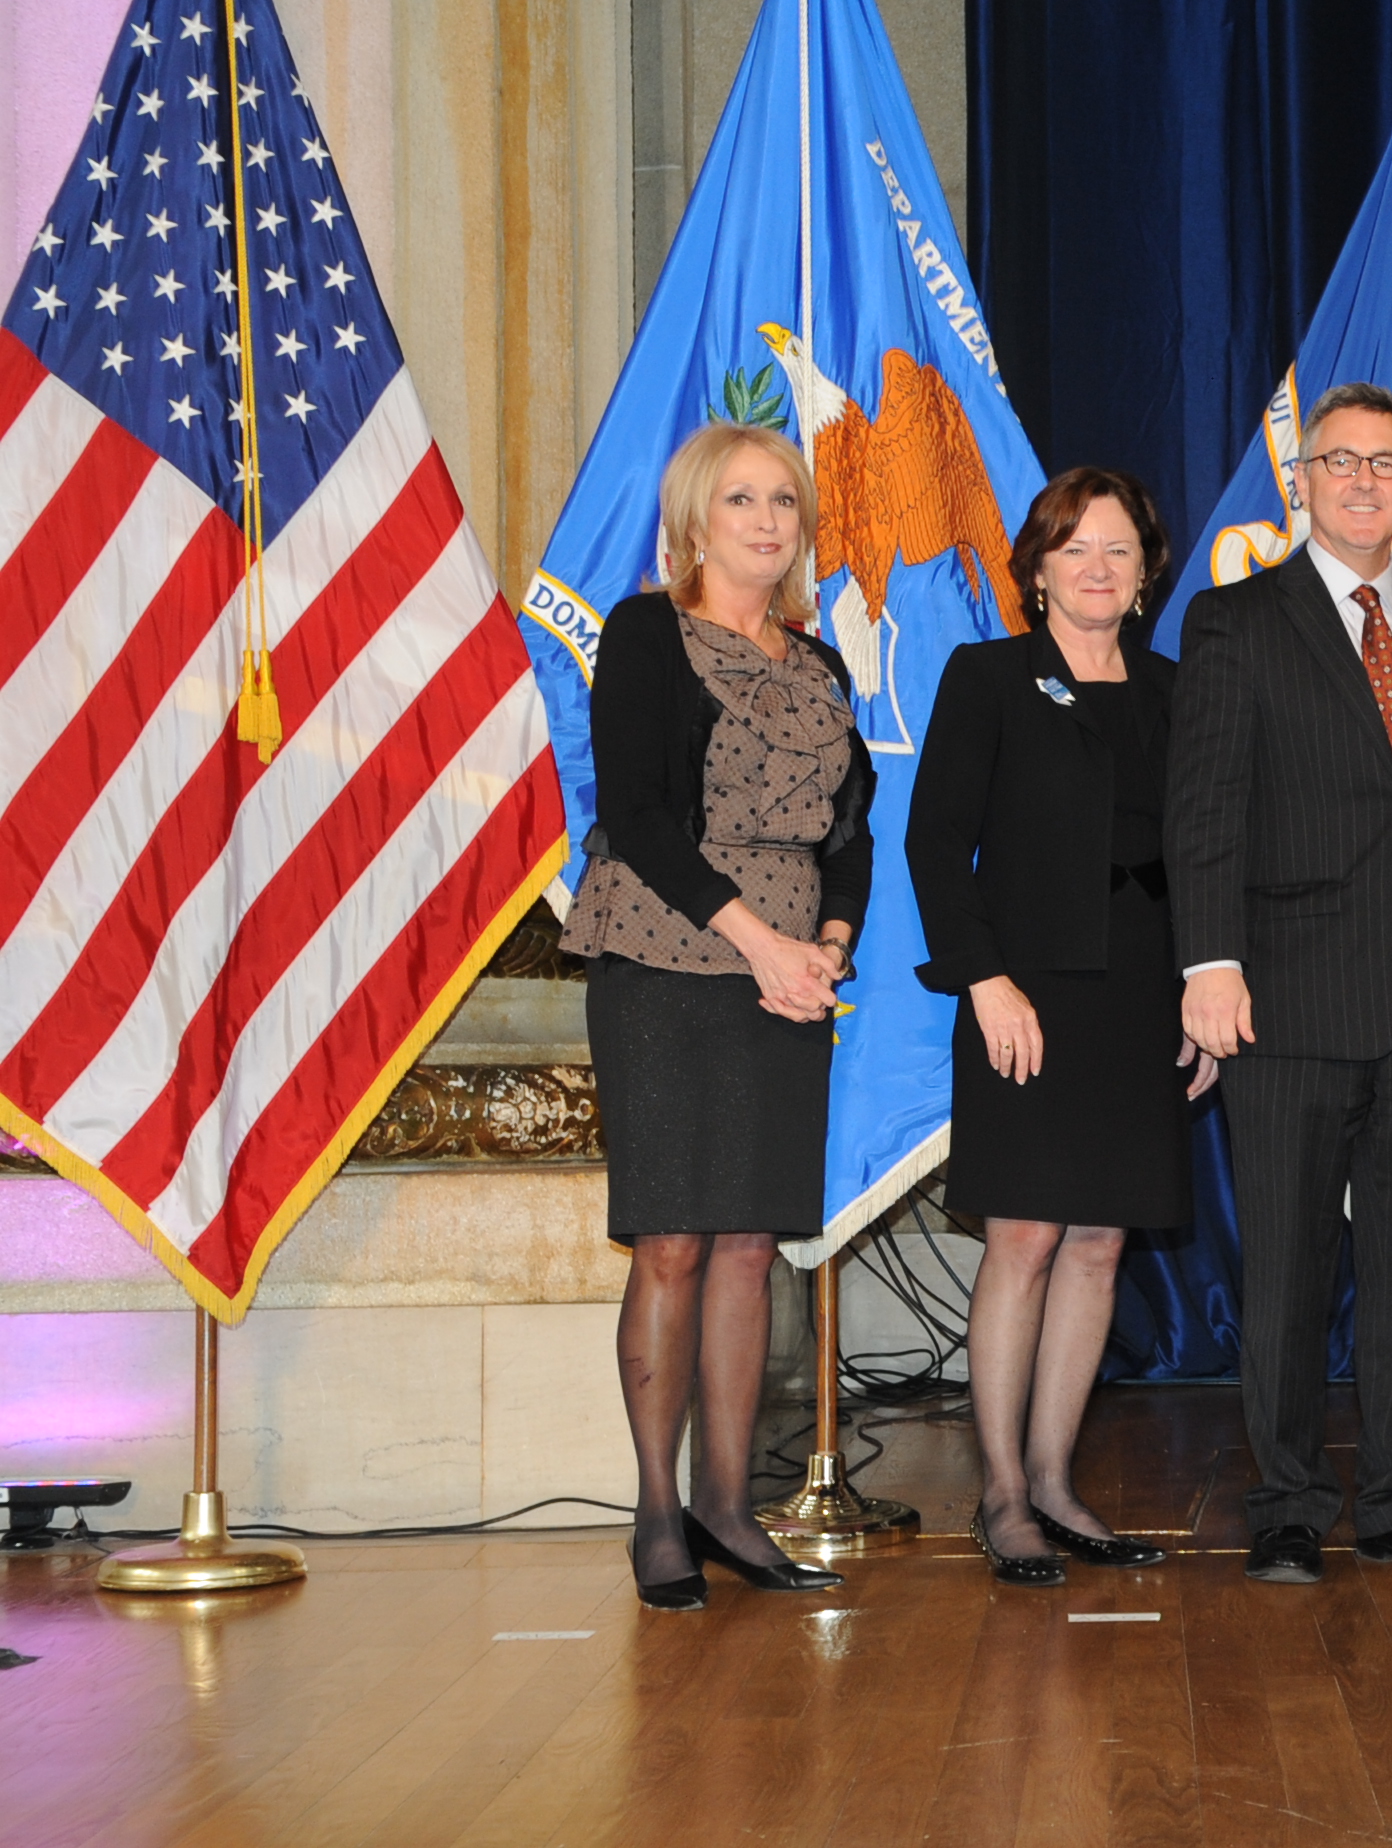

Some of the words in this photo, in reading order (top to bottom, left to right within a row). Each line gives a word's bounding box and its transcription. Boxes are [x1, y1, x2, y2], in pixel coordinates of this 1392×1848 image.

[866, 138, 1007, 398] DEPARTMEN
[1270, 378, 1291, 424] UI
[529, 583, 600, 672] DOM
